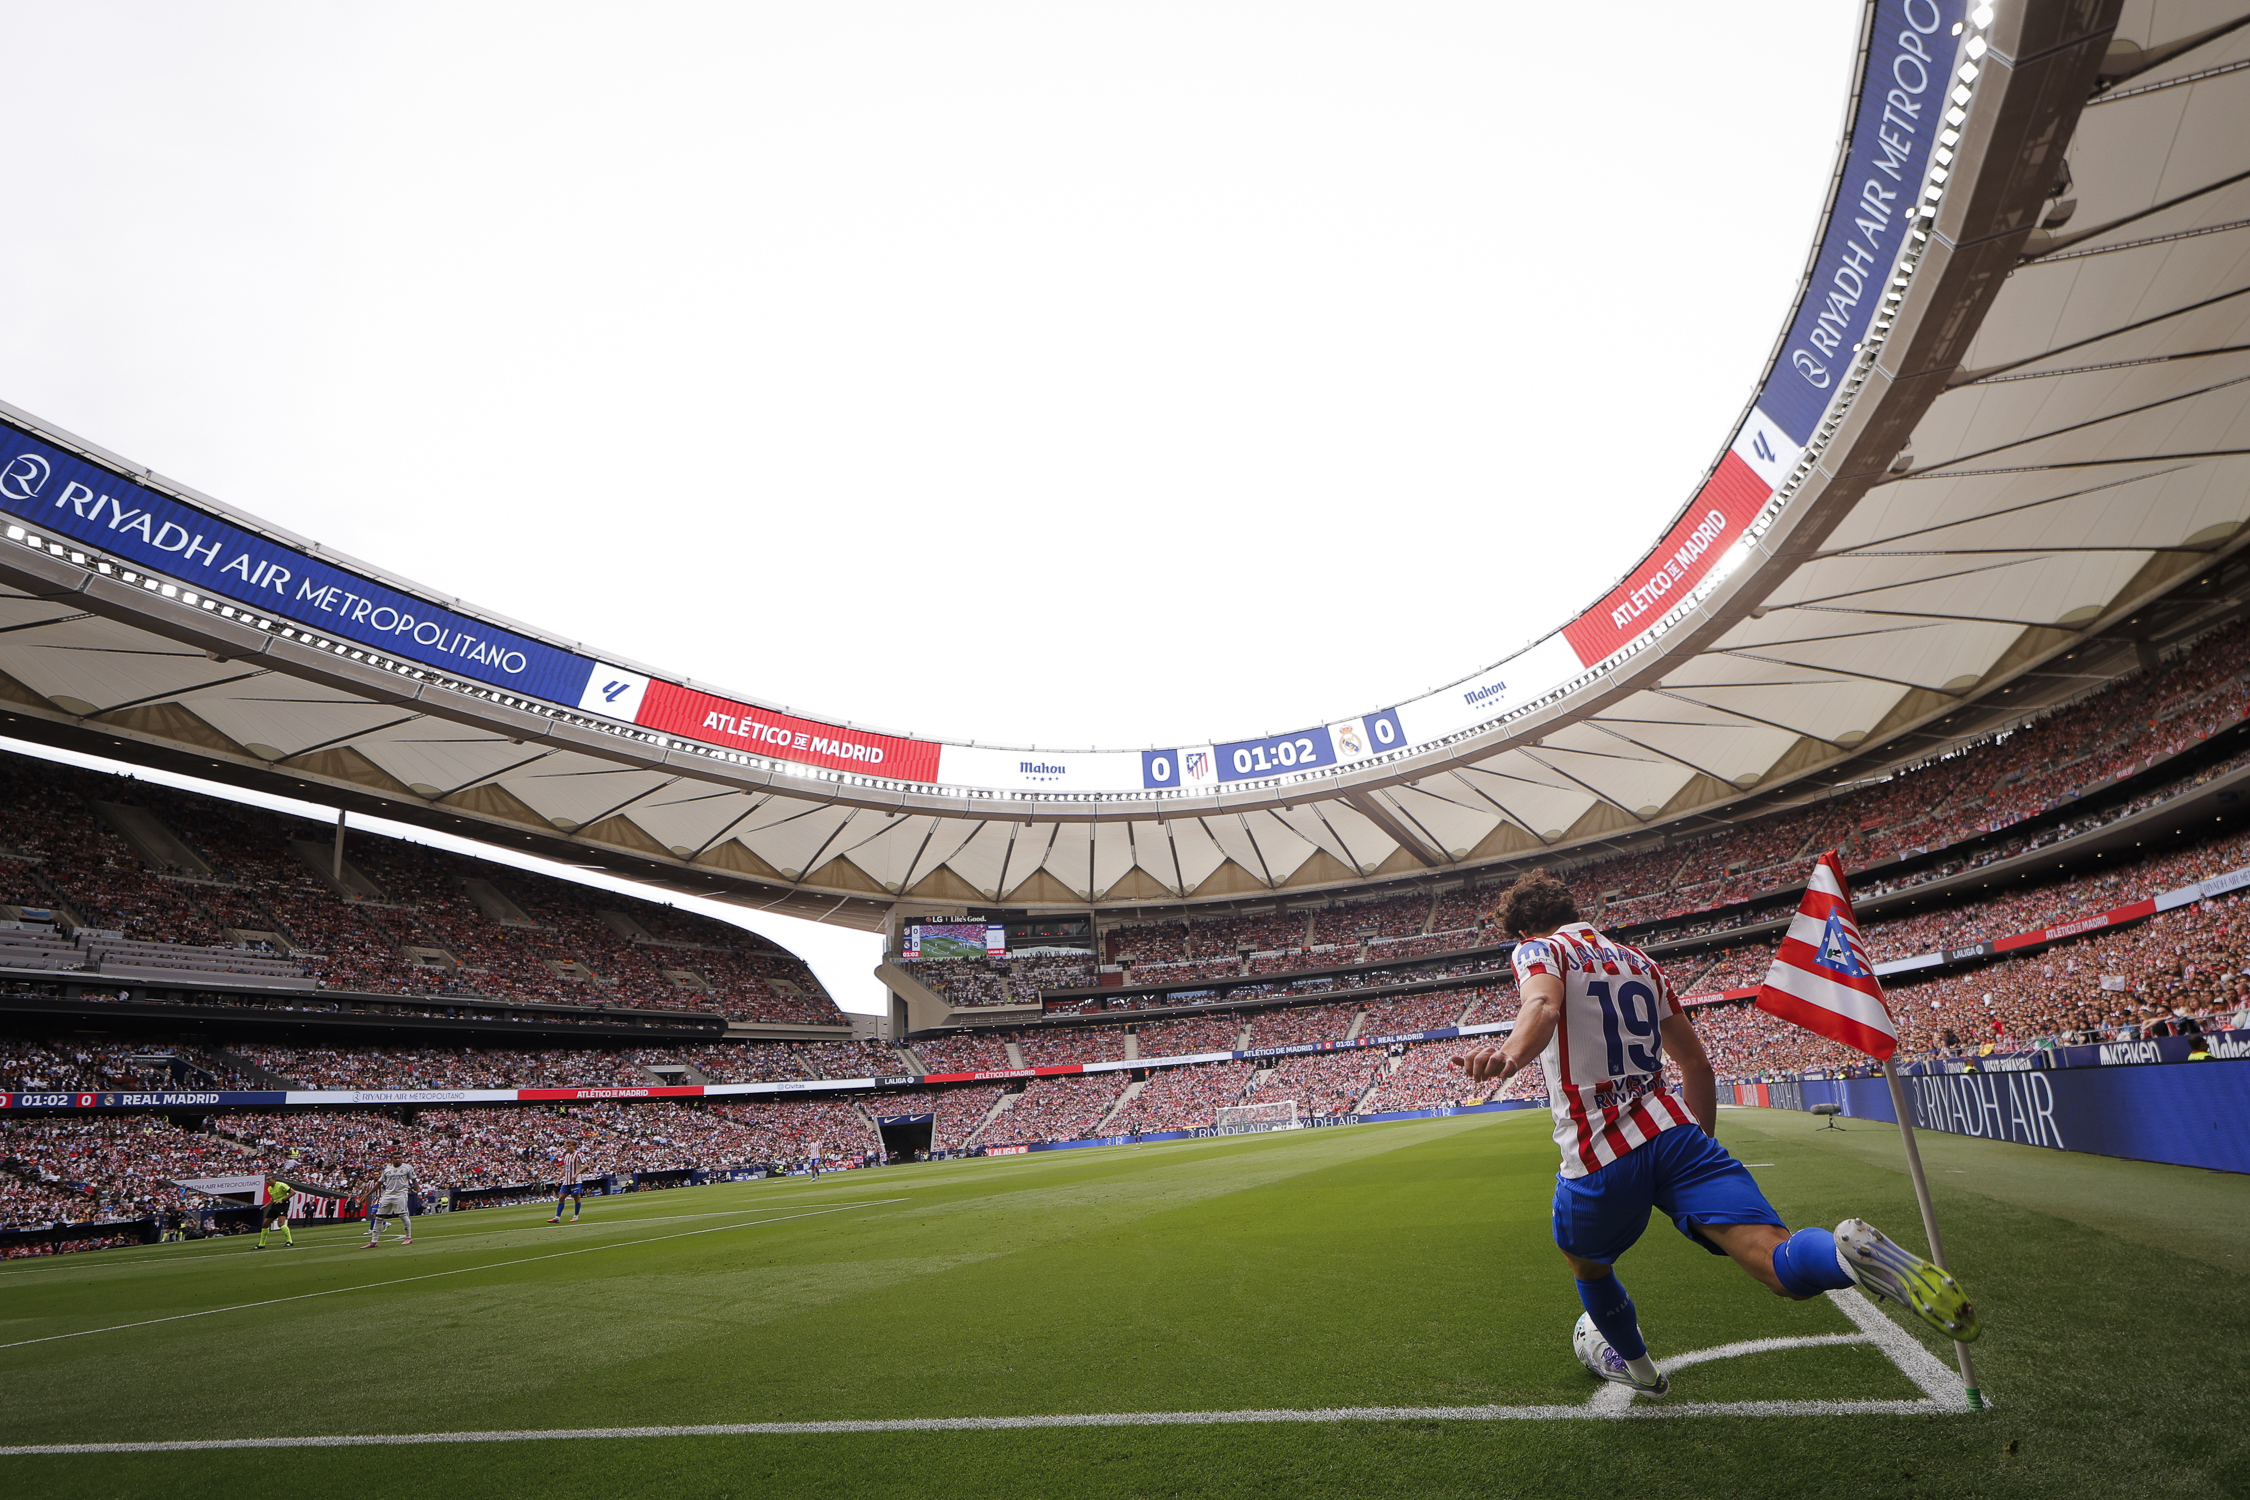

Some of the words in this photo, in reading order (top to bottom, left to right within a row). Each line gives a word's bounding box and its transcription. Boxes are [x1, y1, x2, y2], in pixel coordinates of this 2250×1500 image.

[1809, 238, 1877, 361] RIYADH
[1854, 178, 1898, 251] AIR
[1611, 569, 1673, 631] ATLÉTICO
[1673, 508, 1727, 570] MADRID
[55, 480, 222, 568] RIYADH
[220, 552, 292, 595] AIR
[296, 577, 527, 676] METROPOLITANO
[1463, 679, 1508, 708] Mahou
[702, 711, 792, 747] ATLÉTICO
[792, 734, 808, 748] DE
[809, 736, 884, 764] MADRID
[1151, 759, 1170, 782] 0
[1232, 737, 1317, 774] 01:02
[1377, 717, 1396, 745] 0
[1019, 761, 1066, 775] Mahou
[2045, 925, 2076, 940] ATLÉTICO
[2082, 914, 2109, 931] MADRID
[1952, 947, 1976, 960] LALIGA
[1697, 993, 1725, 1004] MADRID
[1587, 980, 1663, 1075] 19
[1243, 1047, 1275, 1058] ATLÉTICO
[1275, 1047, 1285, 1055] DE
[1285, 1044, 1313, 1054] MADRID
[1335, 1040, 1356, 1048] 01:02
[1378, 1036, 1396, 1044] REAL
[1396, 1033, 1425, 1043] MADRID
[2109, 1040, 2162, 1065] kraken
[1982, 1060, 2000, 1073] VISIT
[974, 1071, 1004, 1080] ATLÉTICO
[1010, 1069, 1036, 1077] MADRID
[21, 1095, 68, 1106] 01:02
[81, 1095, 92, 1106] 0
[122, 1095, 160, 1105] REAL
[163, 1094, 219, 1105] MADRID
[362, 1093, 392, 1101] RIYADH
[409, 1092, 465, 1100] METROPOLITANO
[576, 1088, 612, 1098] ATLÉTICO
[619, 1089, 649, 1097] MADRID
[1922, 1074, 2005, 1140] RIYADH
[2008, 1072, 2064, 1149] AIR
[1249, 1122, 1269, 1133] AIR
[1338, 1116, 1359, 1126] AIR
[988, 1146, 1017, 1157] LALIGA
[217, 1181, 261, 1189] METROPOLITANO
